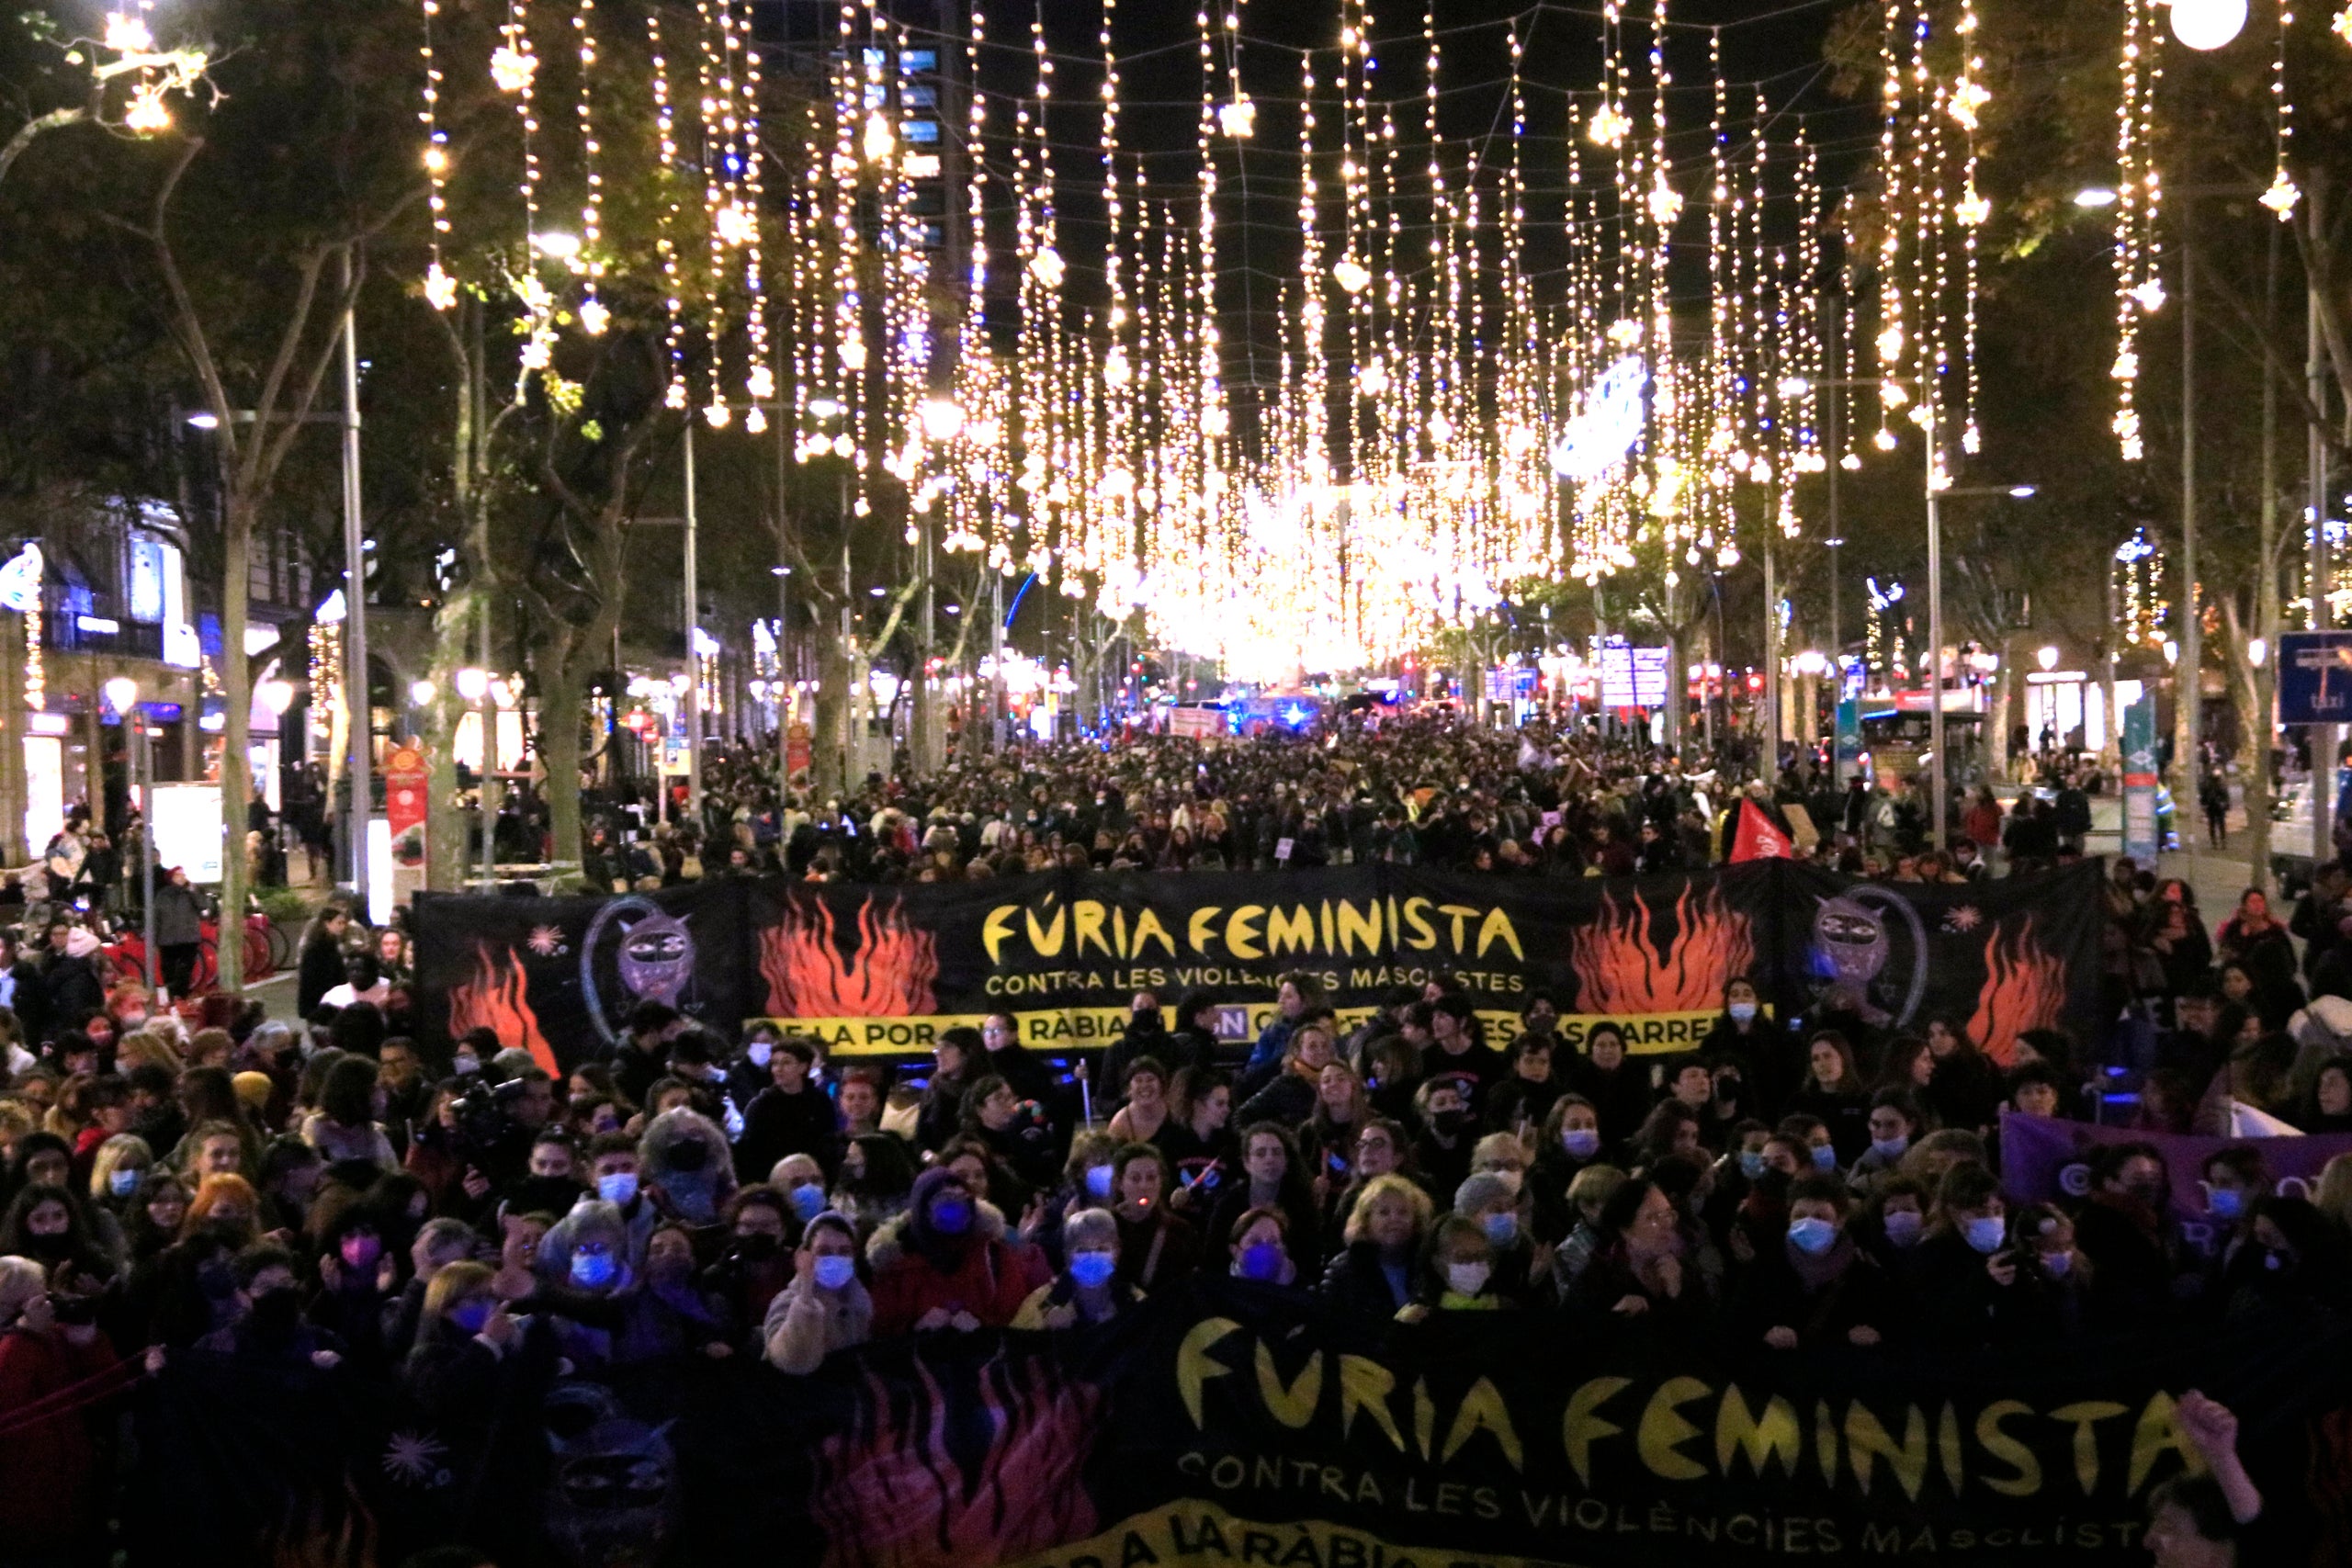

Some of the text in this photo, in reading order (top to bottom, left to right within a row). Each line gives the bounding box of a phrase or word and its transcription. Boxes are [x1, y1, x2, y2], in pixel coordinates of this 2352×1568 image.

[982, 889, 1523, 965] FÚRIA FEMINISTA
[985, 971, 1103, 996] CONTRA
[1113, 967, 1166, 989] LES
[1350, 962, 1525, 993] MASCSTES
[865, 1022, 935, 1046] POR
[1029, 1010, 1125, 1040] RÀBIA
[1623, 1017, 1721, 1044] ARRE
[1176, 1315, 2210, 1502] FÚRIA FEMINISTA
[1177, 1451, 1384, 1504] CONTRA
[1406, 1473, 1502, 1520] LES
[1860, 1514, 2141, 1555] MASCLIST
[1169, 1514, 1233, 1558] LA
[1243, 1521, 1411, 1568] RÀBI
